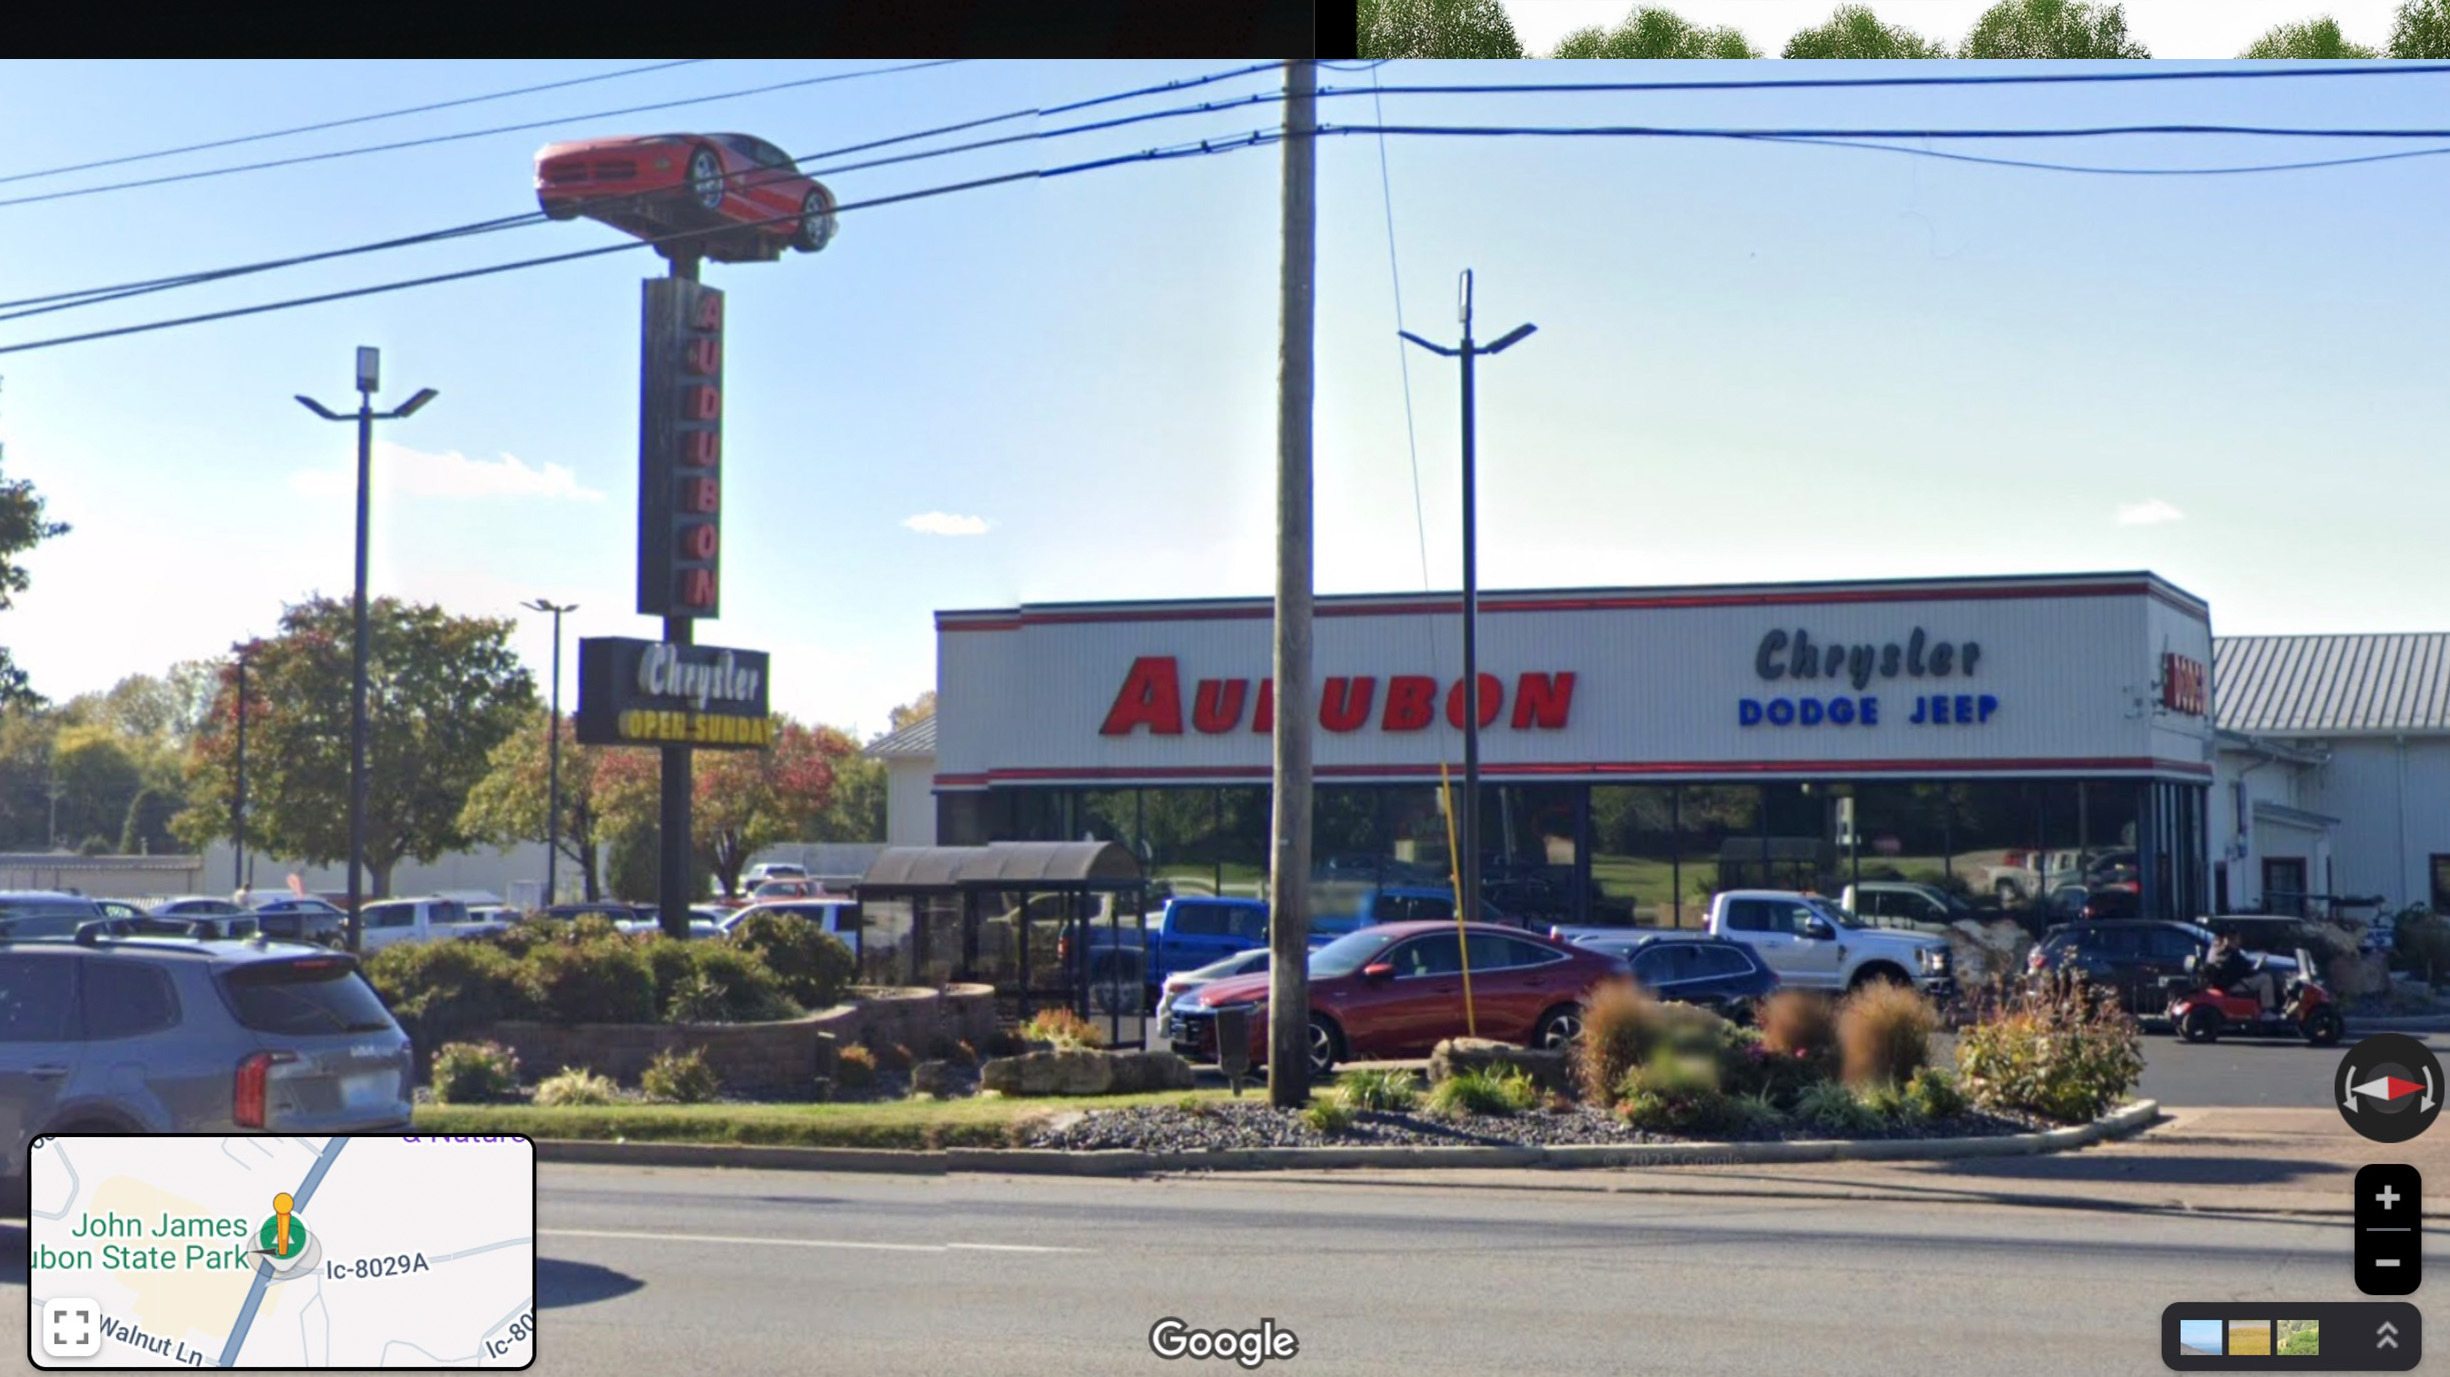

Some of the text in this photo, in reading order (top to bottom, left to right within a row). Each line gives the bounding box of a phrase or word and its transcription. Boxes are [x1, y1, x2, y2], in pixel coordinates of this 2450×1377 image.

[692, 293, 721, 607] AUDUBON
[640, 643, 759, 710] Chrysler
[1756, 626, 1981, 691] Chrysler
[621, 709, 776, 746] OPEN SUNDAY
[1738, 694, 1998, 726] DODGE JEEP
